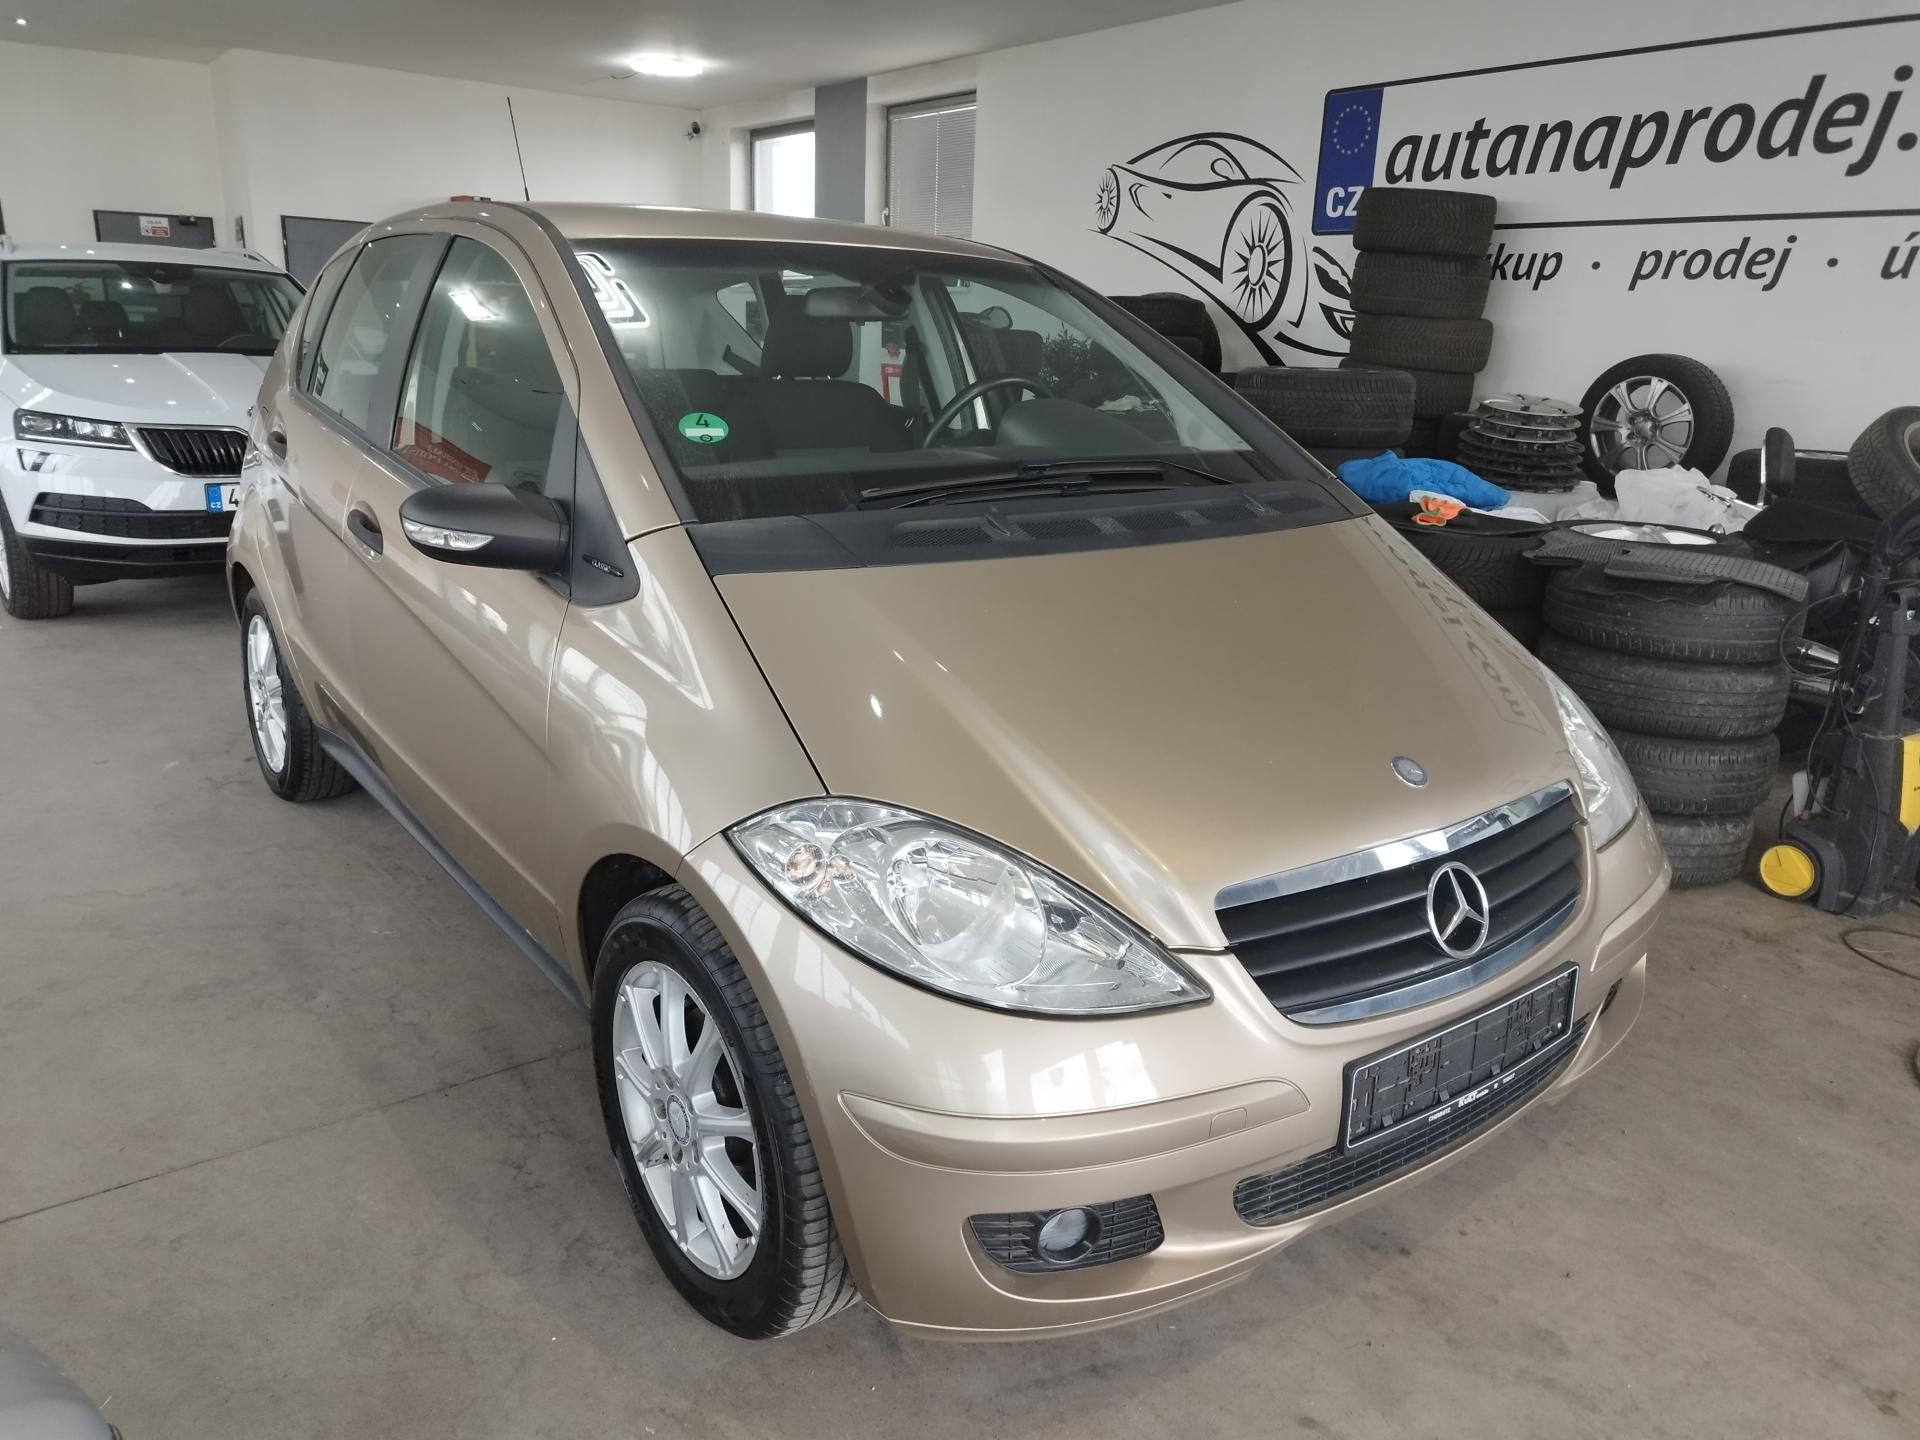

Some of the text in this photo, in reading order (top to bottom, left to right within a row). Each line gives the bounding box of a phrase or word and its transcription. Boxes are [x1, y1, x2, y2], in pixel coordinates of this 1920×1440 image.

[1384, 64, 1919, 189] autanaprodej.
[1326, 185, 1364, 217] CZ
[1485, 242, 1563, 291] kup
[1628, 235, 1798, 291] prodej
[695, 413, 710, 428] 4
